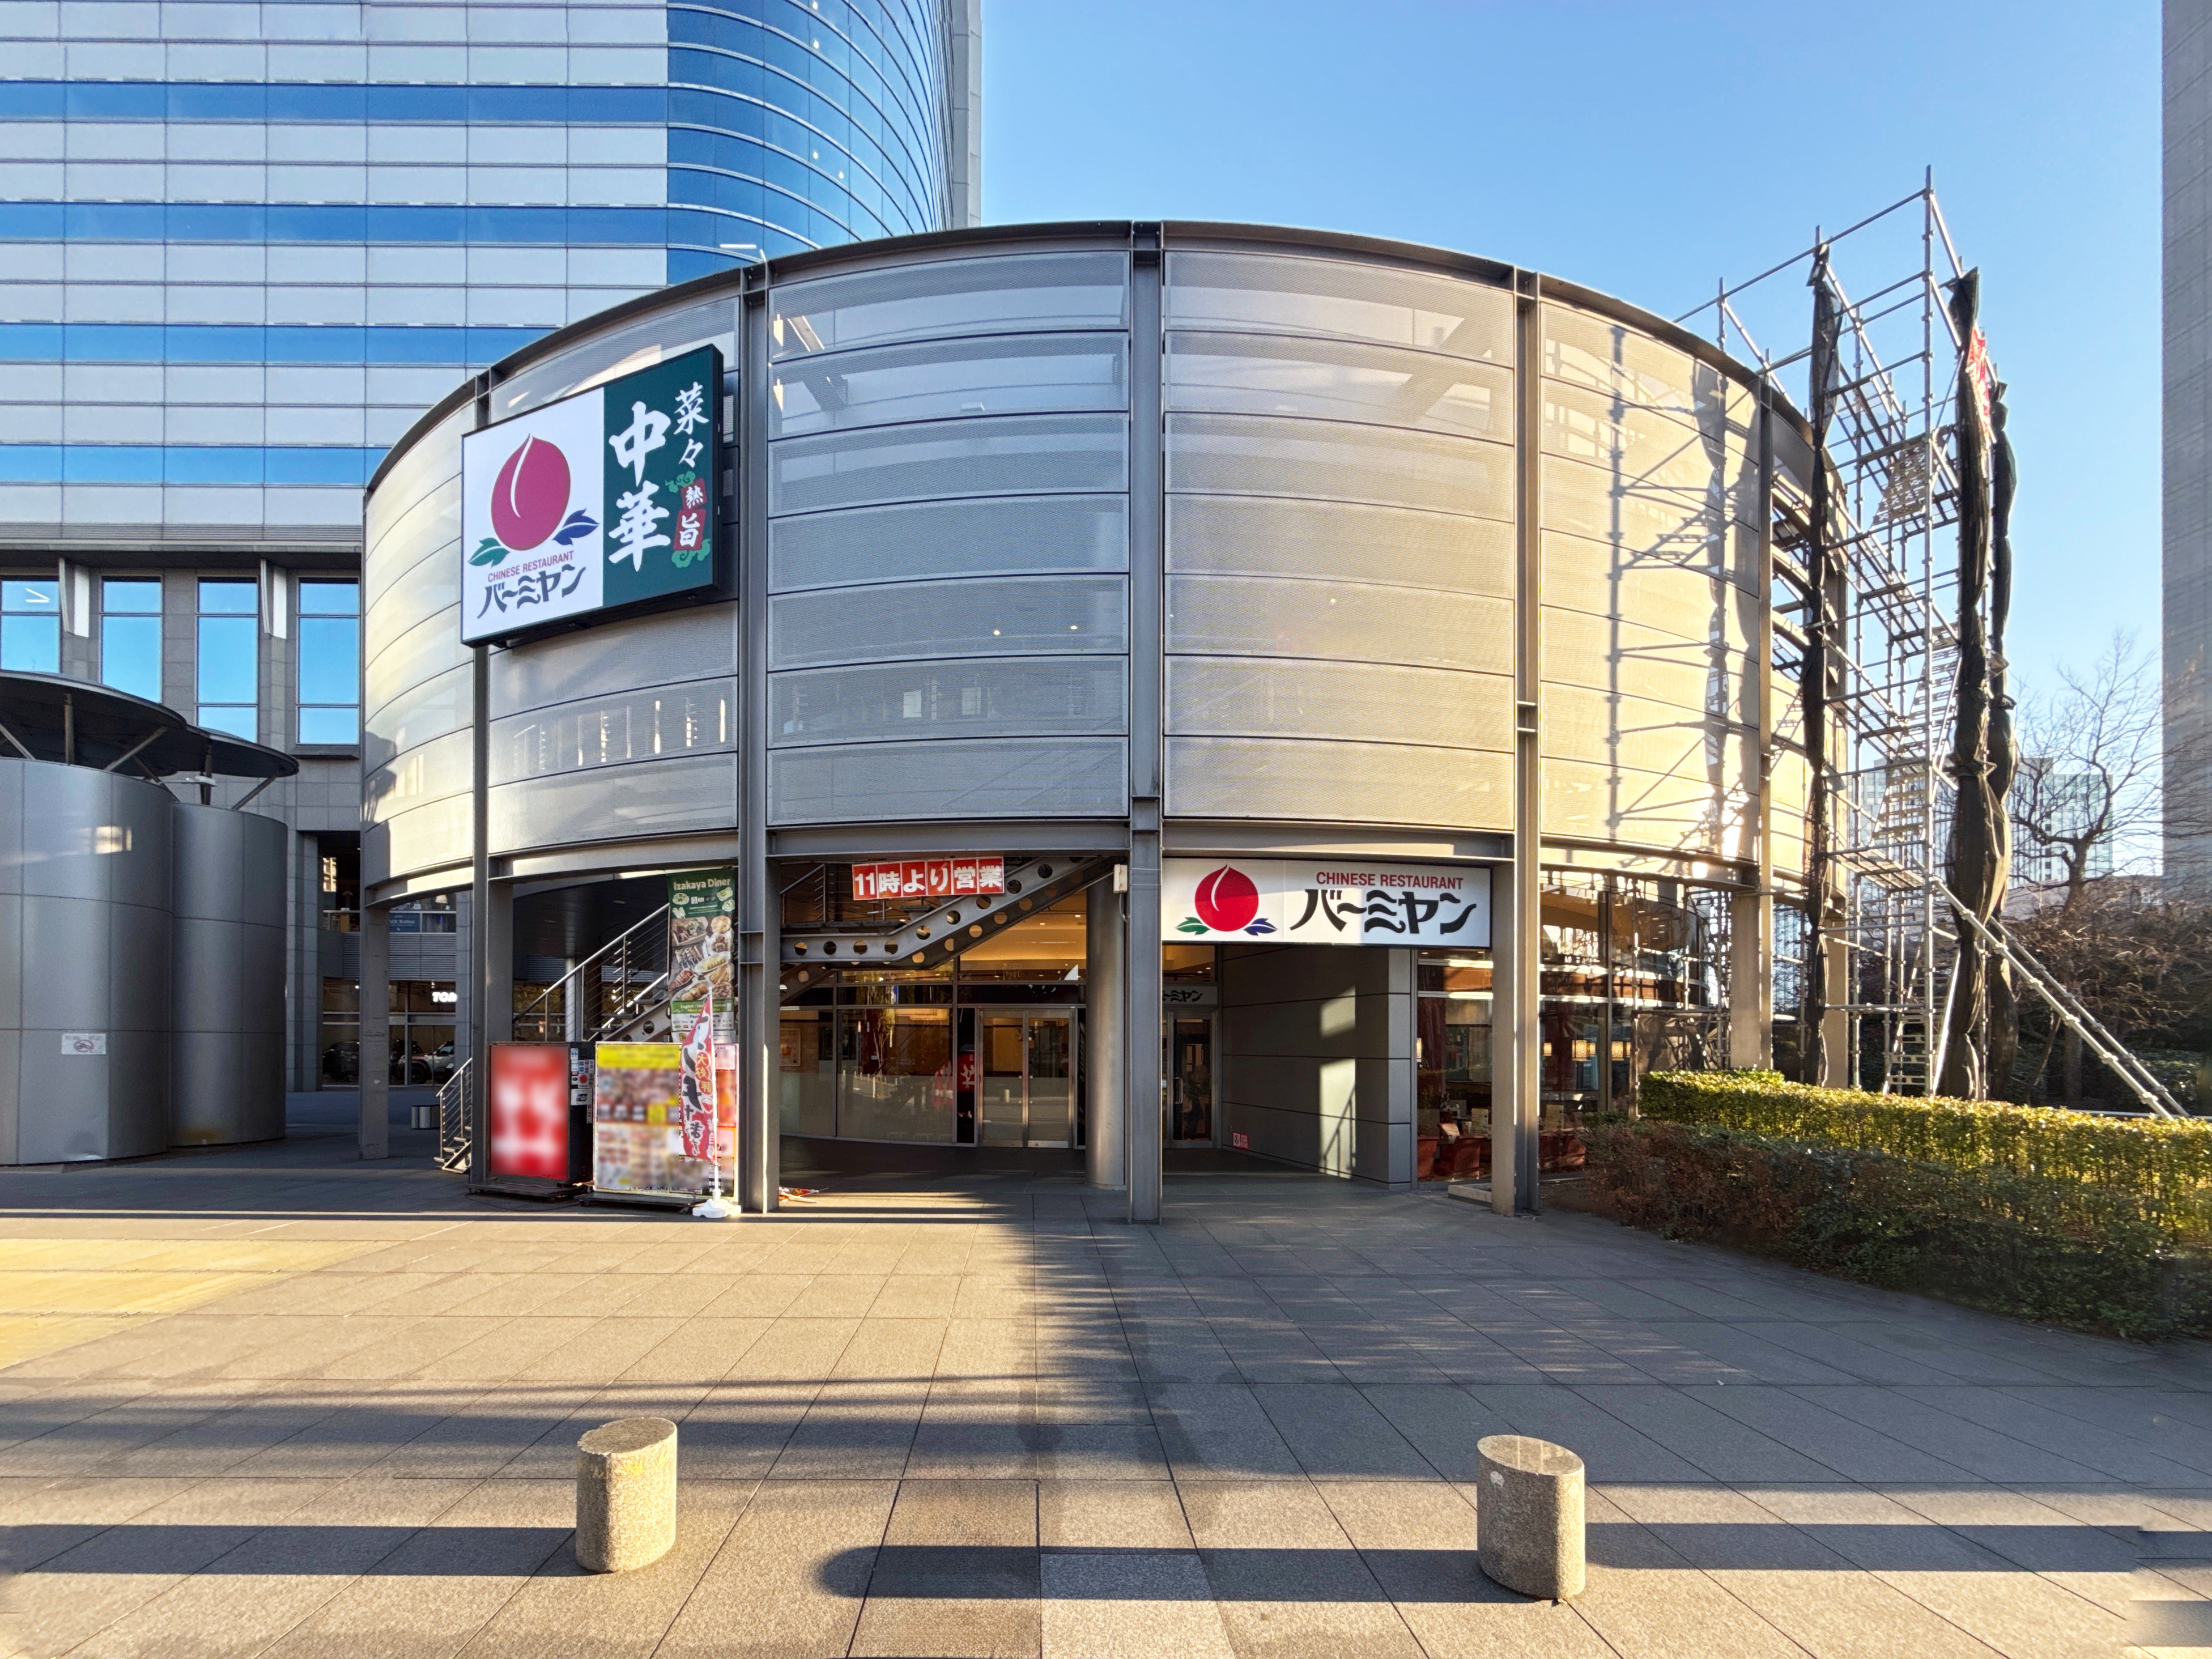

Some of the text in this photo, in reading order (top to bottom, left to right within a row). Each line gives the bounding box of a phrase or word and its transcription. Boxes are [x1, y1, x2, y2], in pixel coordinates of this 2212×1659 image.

[674, 381, 709, 468] 菜々
[608, 401, 671, 572] 中華
[488, 550, 574, 582] CHINESE RESTAURANT
[477, 564, 586, 619] バーミヤン
[673, 878, 731, 891] Izakaya Diner
[854, 865, 1002, 896] 11時より営業
[1316, 871, 1464, 890] CHINESE RESTAURANT
[1289, 888, 1477, 935] バーミヤン
[1163, 990, 1203, 1002] ーミヤン
